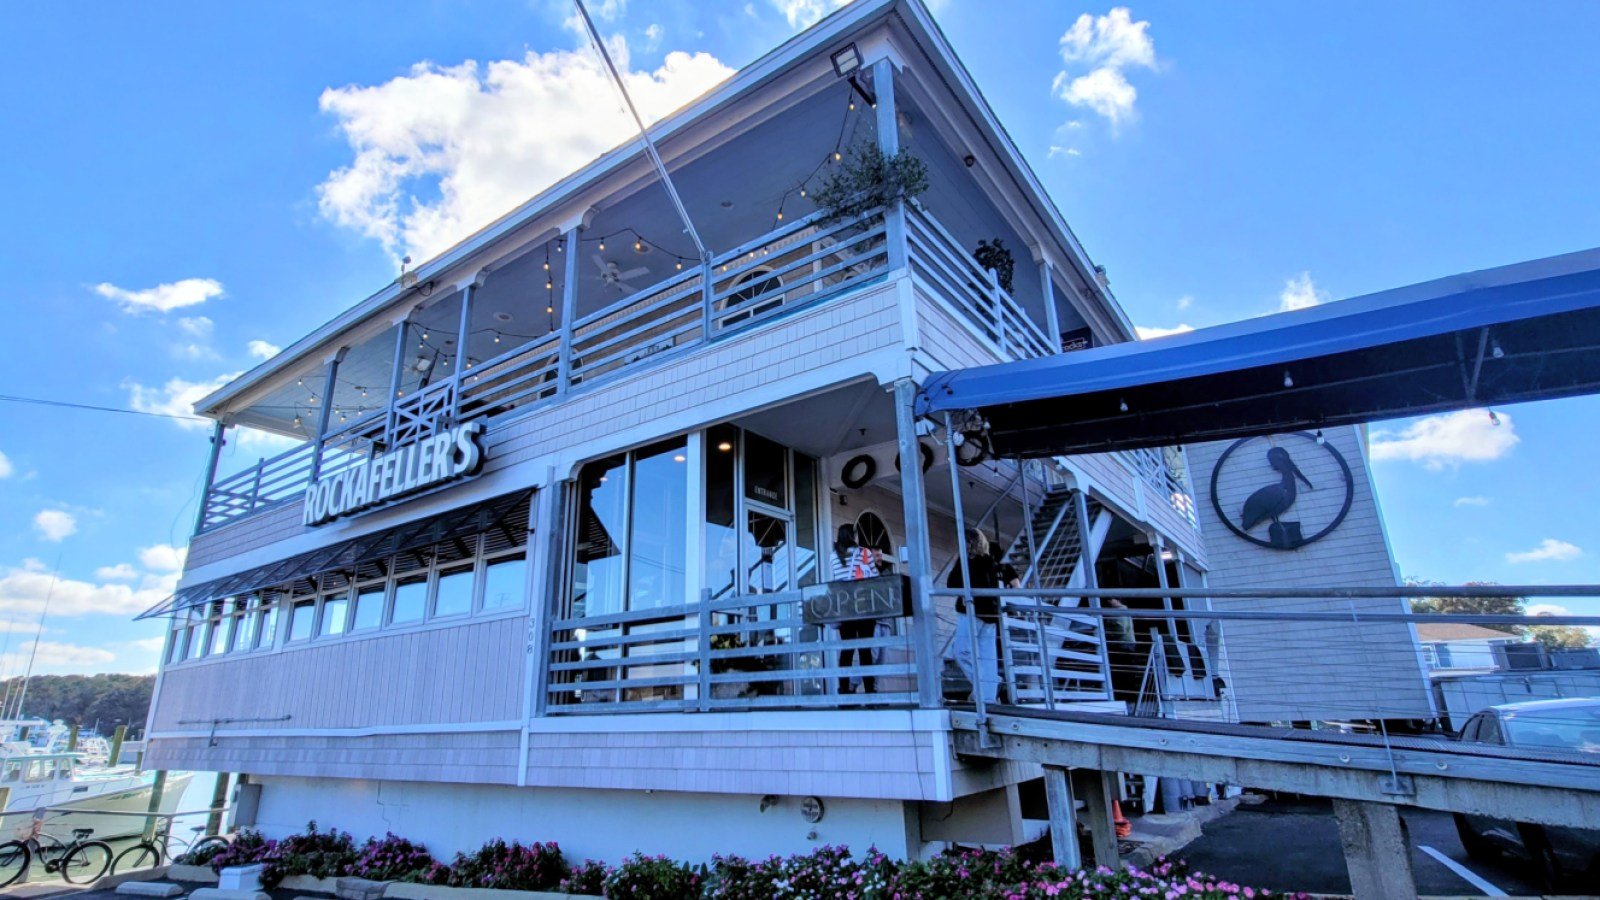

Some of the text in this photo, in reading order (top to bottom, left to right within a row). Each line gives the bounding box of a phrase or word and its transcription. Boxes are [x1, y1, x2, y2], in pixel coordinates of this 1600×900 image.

[302, 420, 480, 525] ROCKAFELLER'S
[754, 485, 778, 500] ENTRANCE
[810, 586, 895, 619] OPEN
[527, 617, 536, 655] 308
